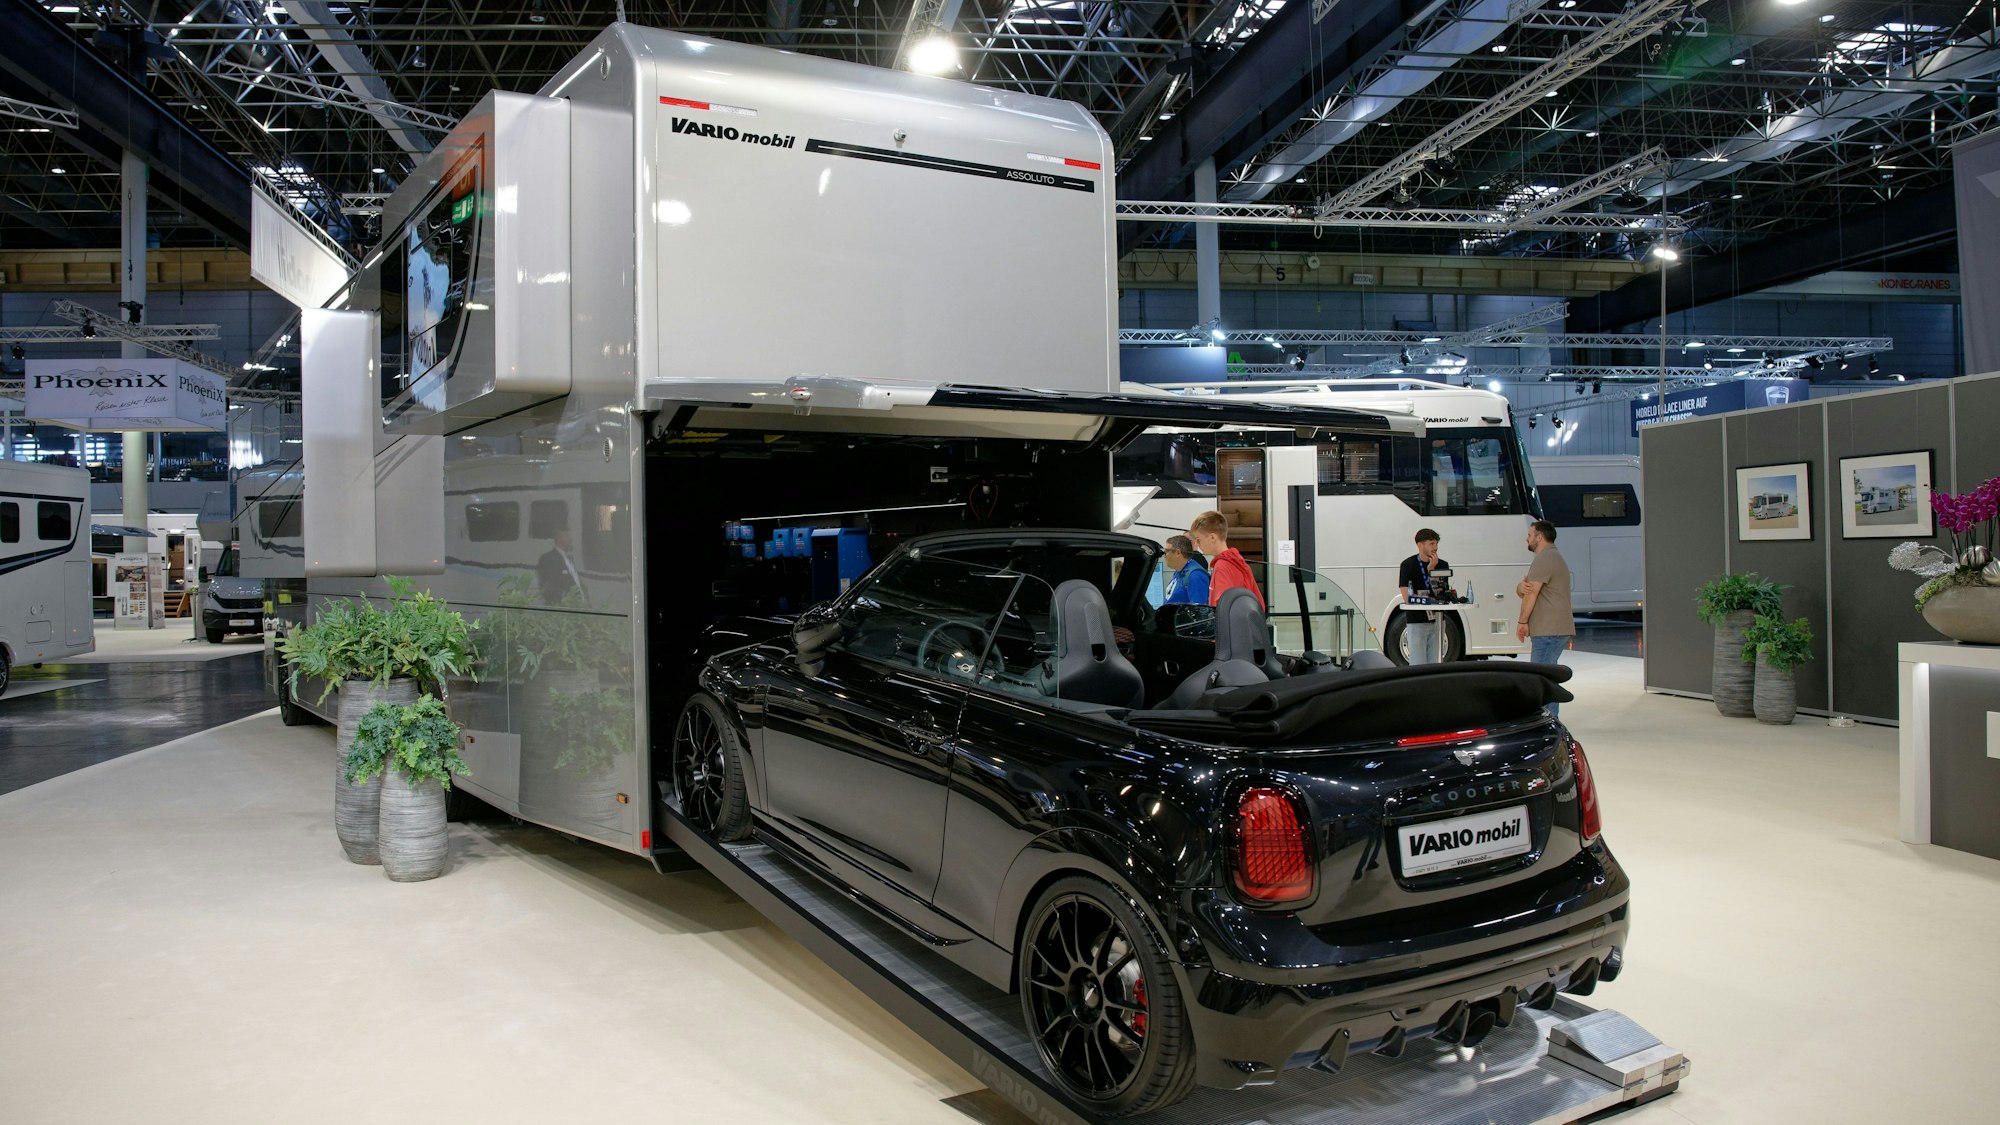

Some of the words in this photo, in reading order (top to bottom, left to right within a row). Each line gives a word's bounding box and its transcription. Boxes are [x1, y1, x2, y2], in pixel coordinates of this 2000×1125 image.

[671, 117, 739, 140] VARIO
[741, 133, 795, 149] mobil
[1006, 170, 1055, 184] ASSOLUTO
[1276, 267, 1286, 281] 5
[1880, 279, 1951, 289] KONECRANES
[33, 374, 168, 388] PhoeniX
[1635, 405, 1658, 419] MORELO
[1658, 401, 1678, 415] PLACE
[1678, 398, 1695, 412] LINER
[1696, 396, 1708, 409] AUF
[1430, 780, 1521, 803] COOPER
[1409, 828, 1474, 857] VARIO
[1475, 818, 1521, 845] mobil
[973, 1048, 1038, 1113] VARIO
